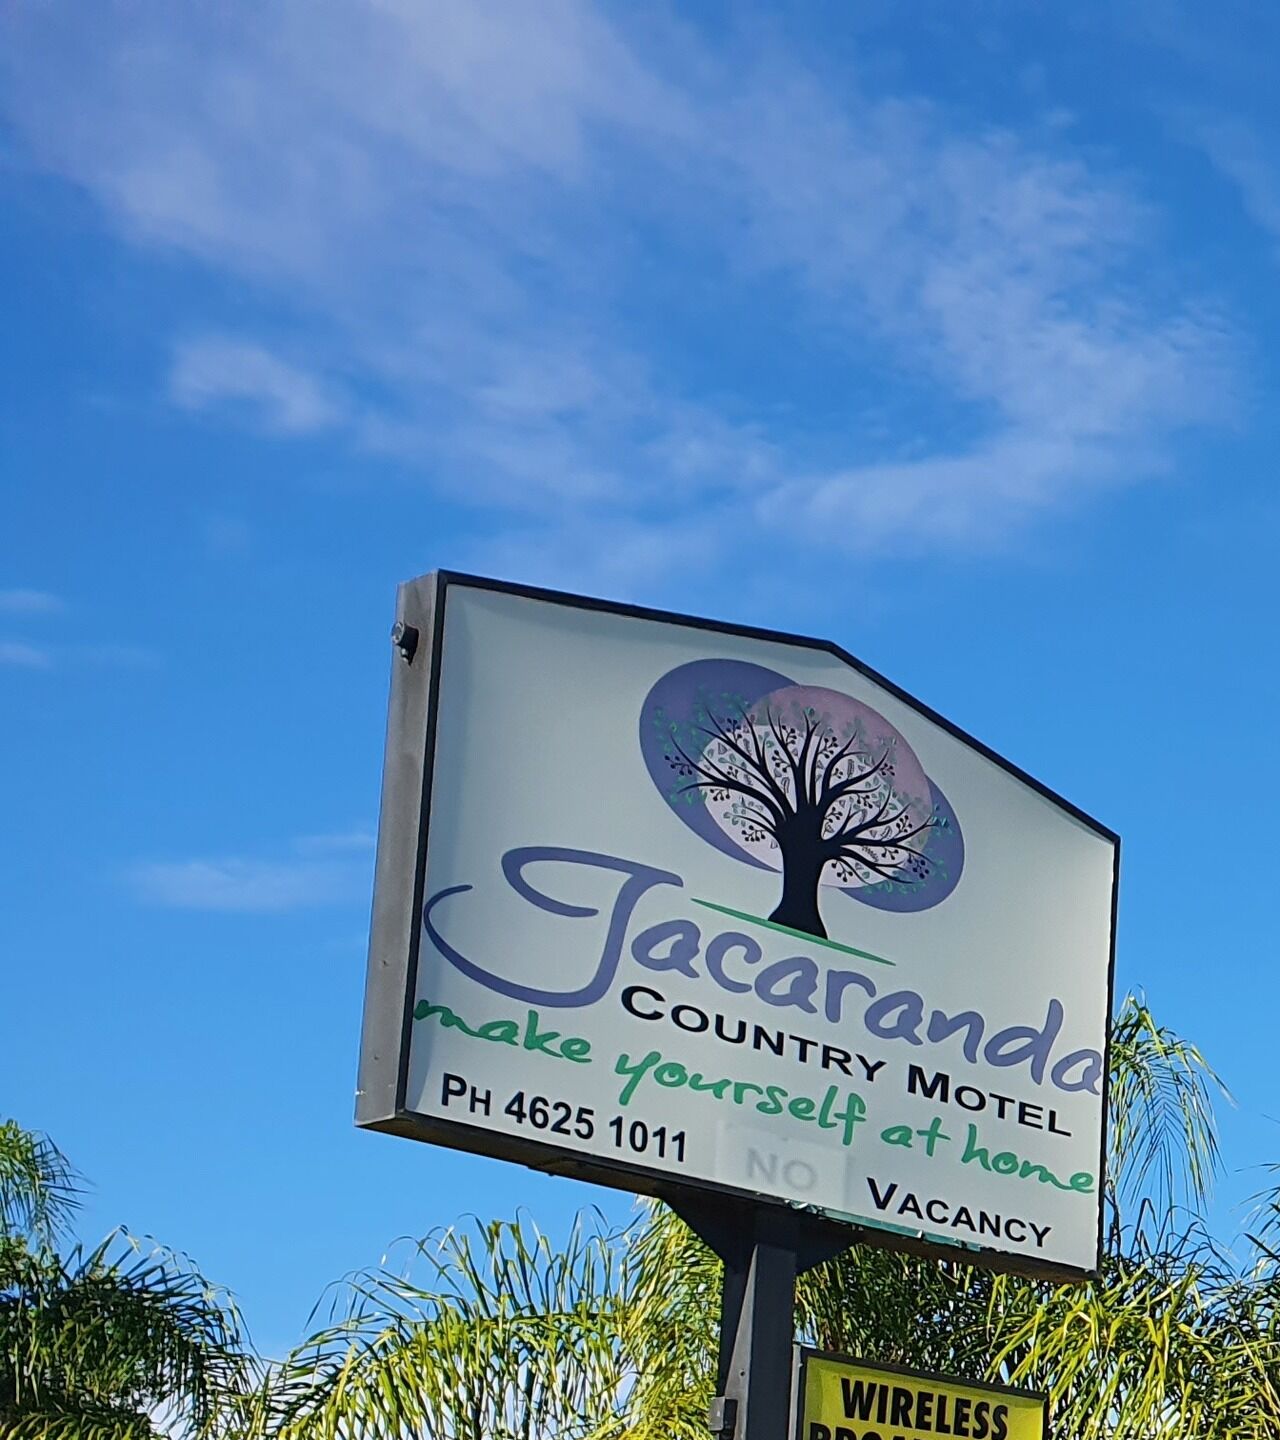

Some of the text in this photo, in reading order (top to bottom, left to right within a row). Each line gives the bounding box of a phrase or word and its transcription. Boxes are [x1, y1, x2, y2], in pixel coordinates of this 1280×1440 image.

[424, 846, 1102, 1096] Jacaranda
[413, 999, 1095, 1194] make yourself at home
[441, 1072, 687, 1163] PH 4625 1011
[620, 985, 1072, 1138] COUNTRY MOTEL
[747, 1149, 1052, 1248] NO VACANCY
